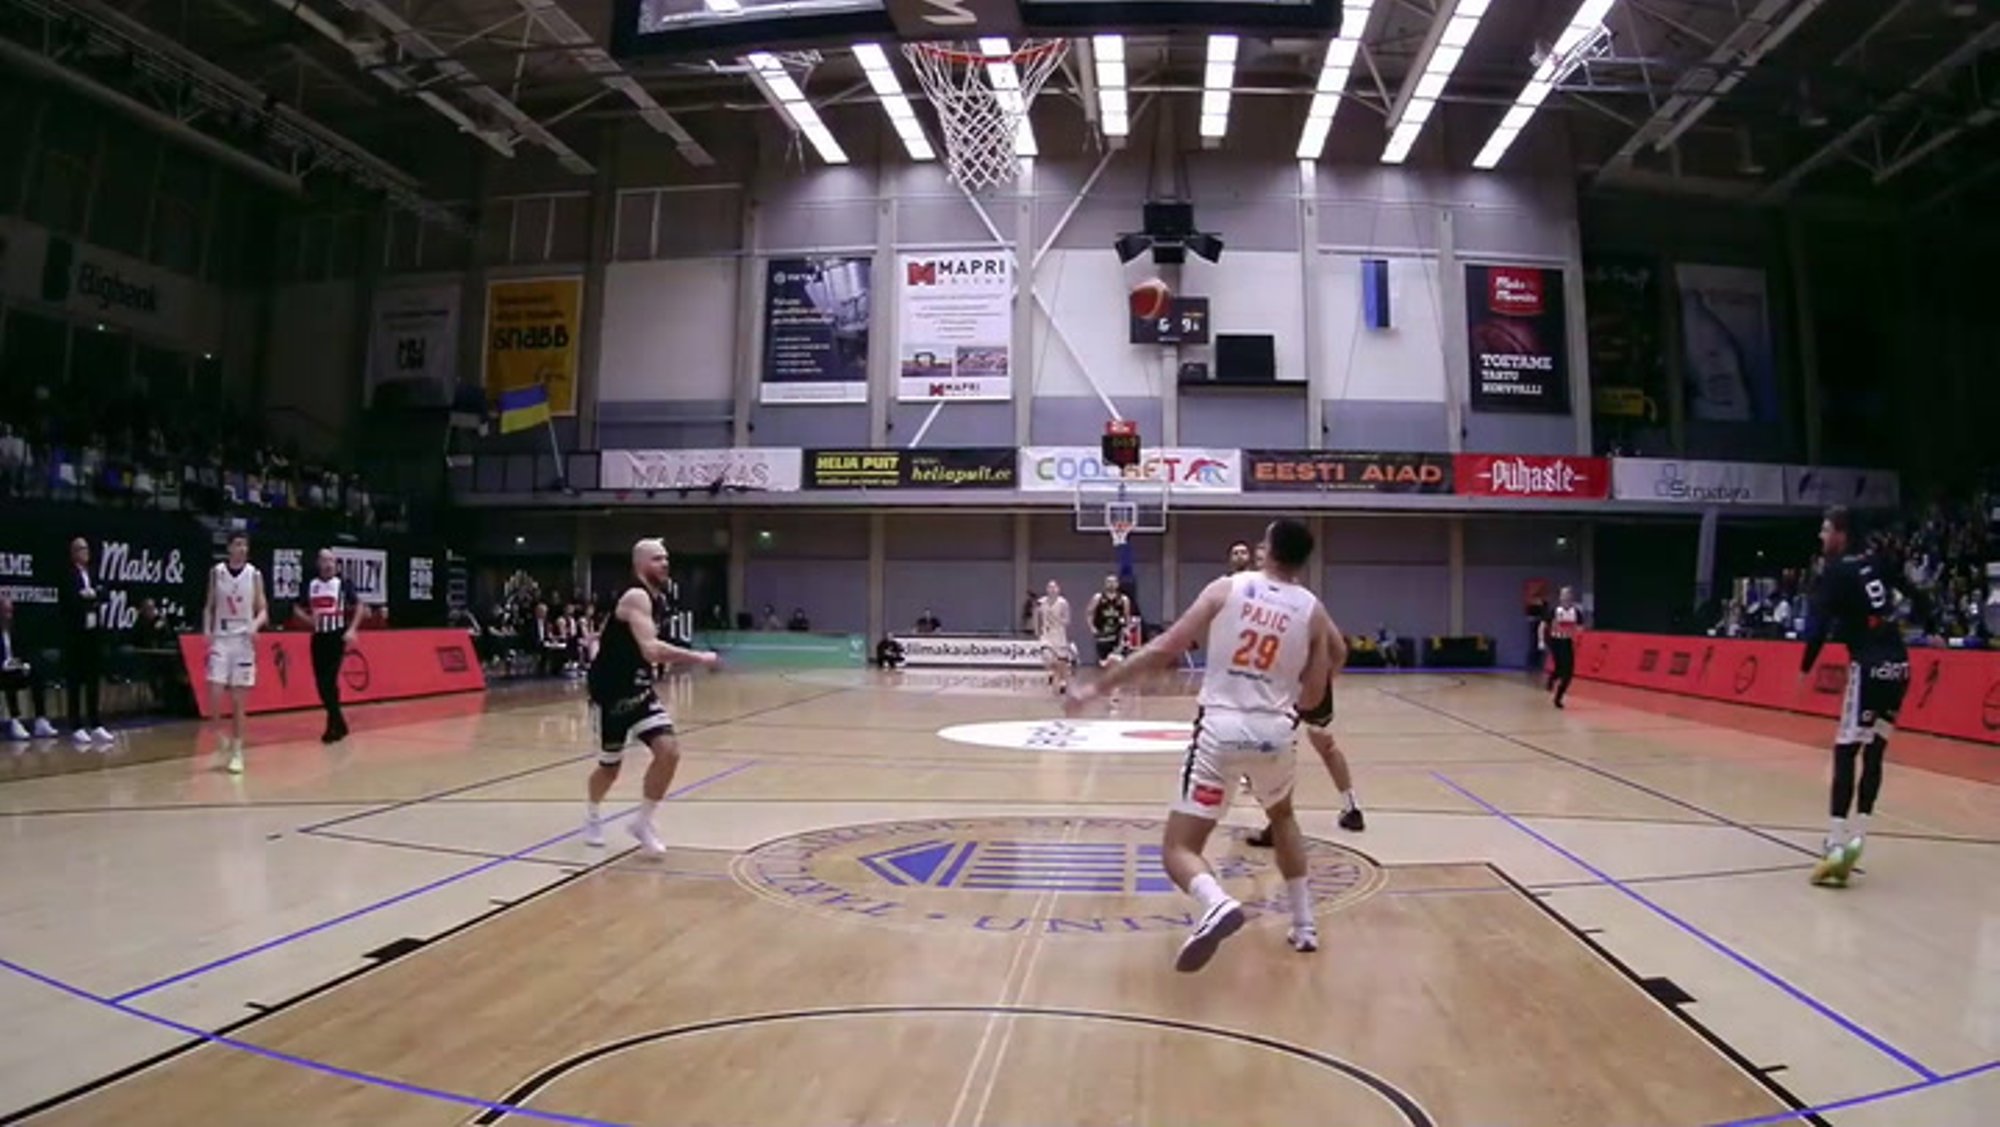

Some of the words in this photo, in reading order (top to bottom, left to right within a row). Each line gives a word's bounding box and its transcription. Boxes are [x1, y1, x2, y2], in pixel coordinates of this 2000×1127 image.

[938, 259, 1005, 276] MAPRI
[79, 262, 157, 311] Bigbank
[817, 456, 859, 470] HELIA
[862, 456, 900, 470] PUIT
[1253, 461, 1346, 482] EESTI
[1360, 463, 1442, 482] AIAD
[911, 465, 1012, 484] heliapuit.ee
[98, 540, 162, 584] Maks
[164, 548, 184, 584] &
[1232, 629, 1281, 671] 29
